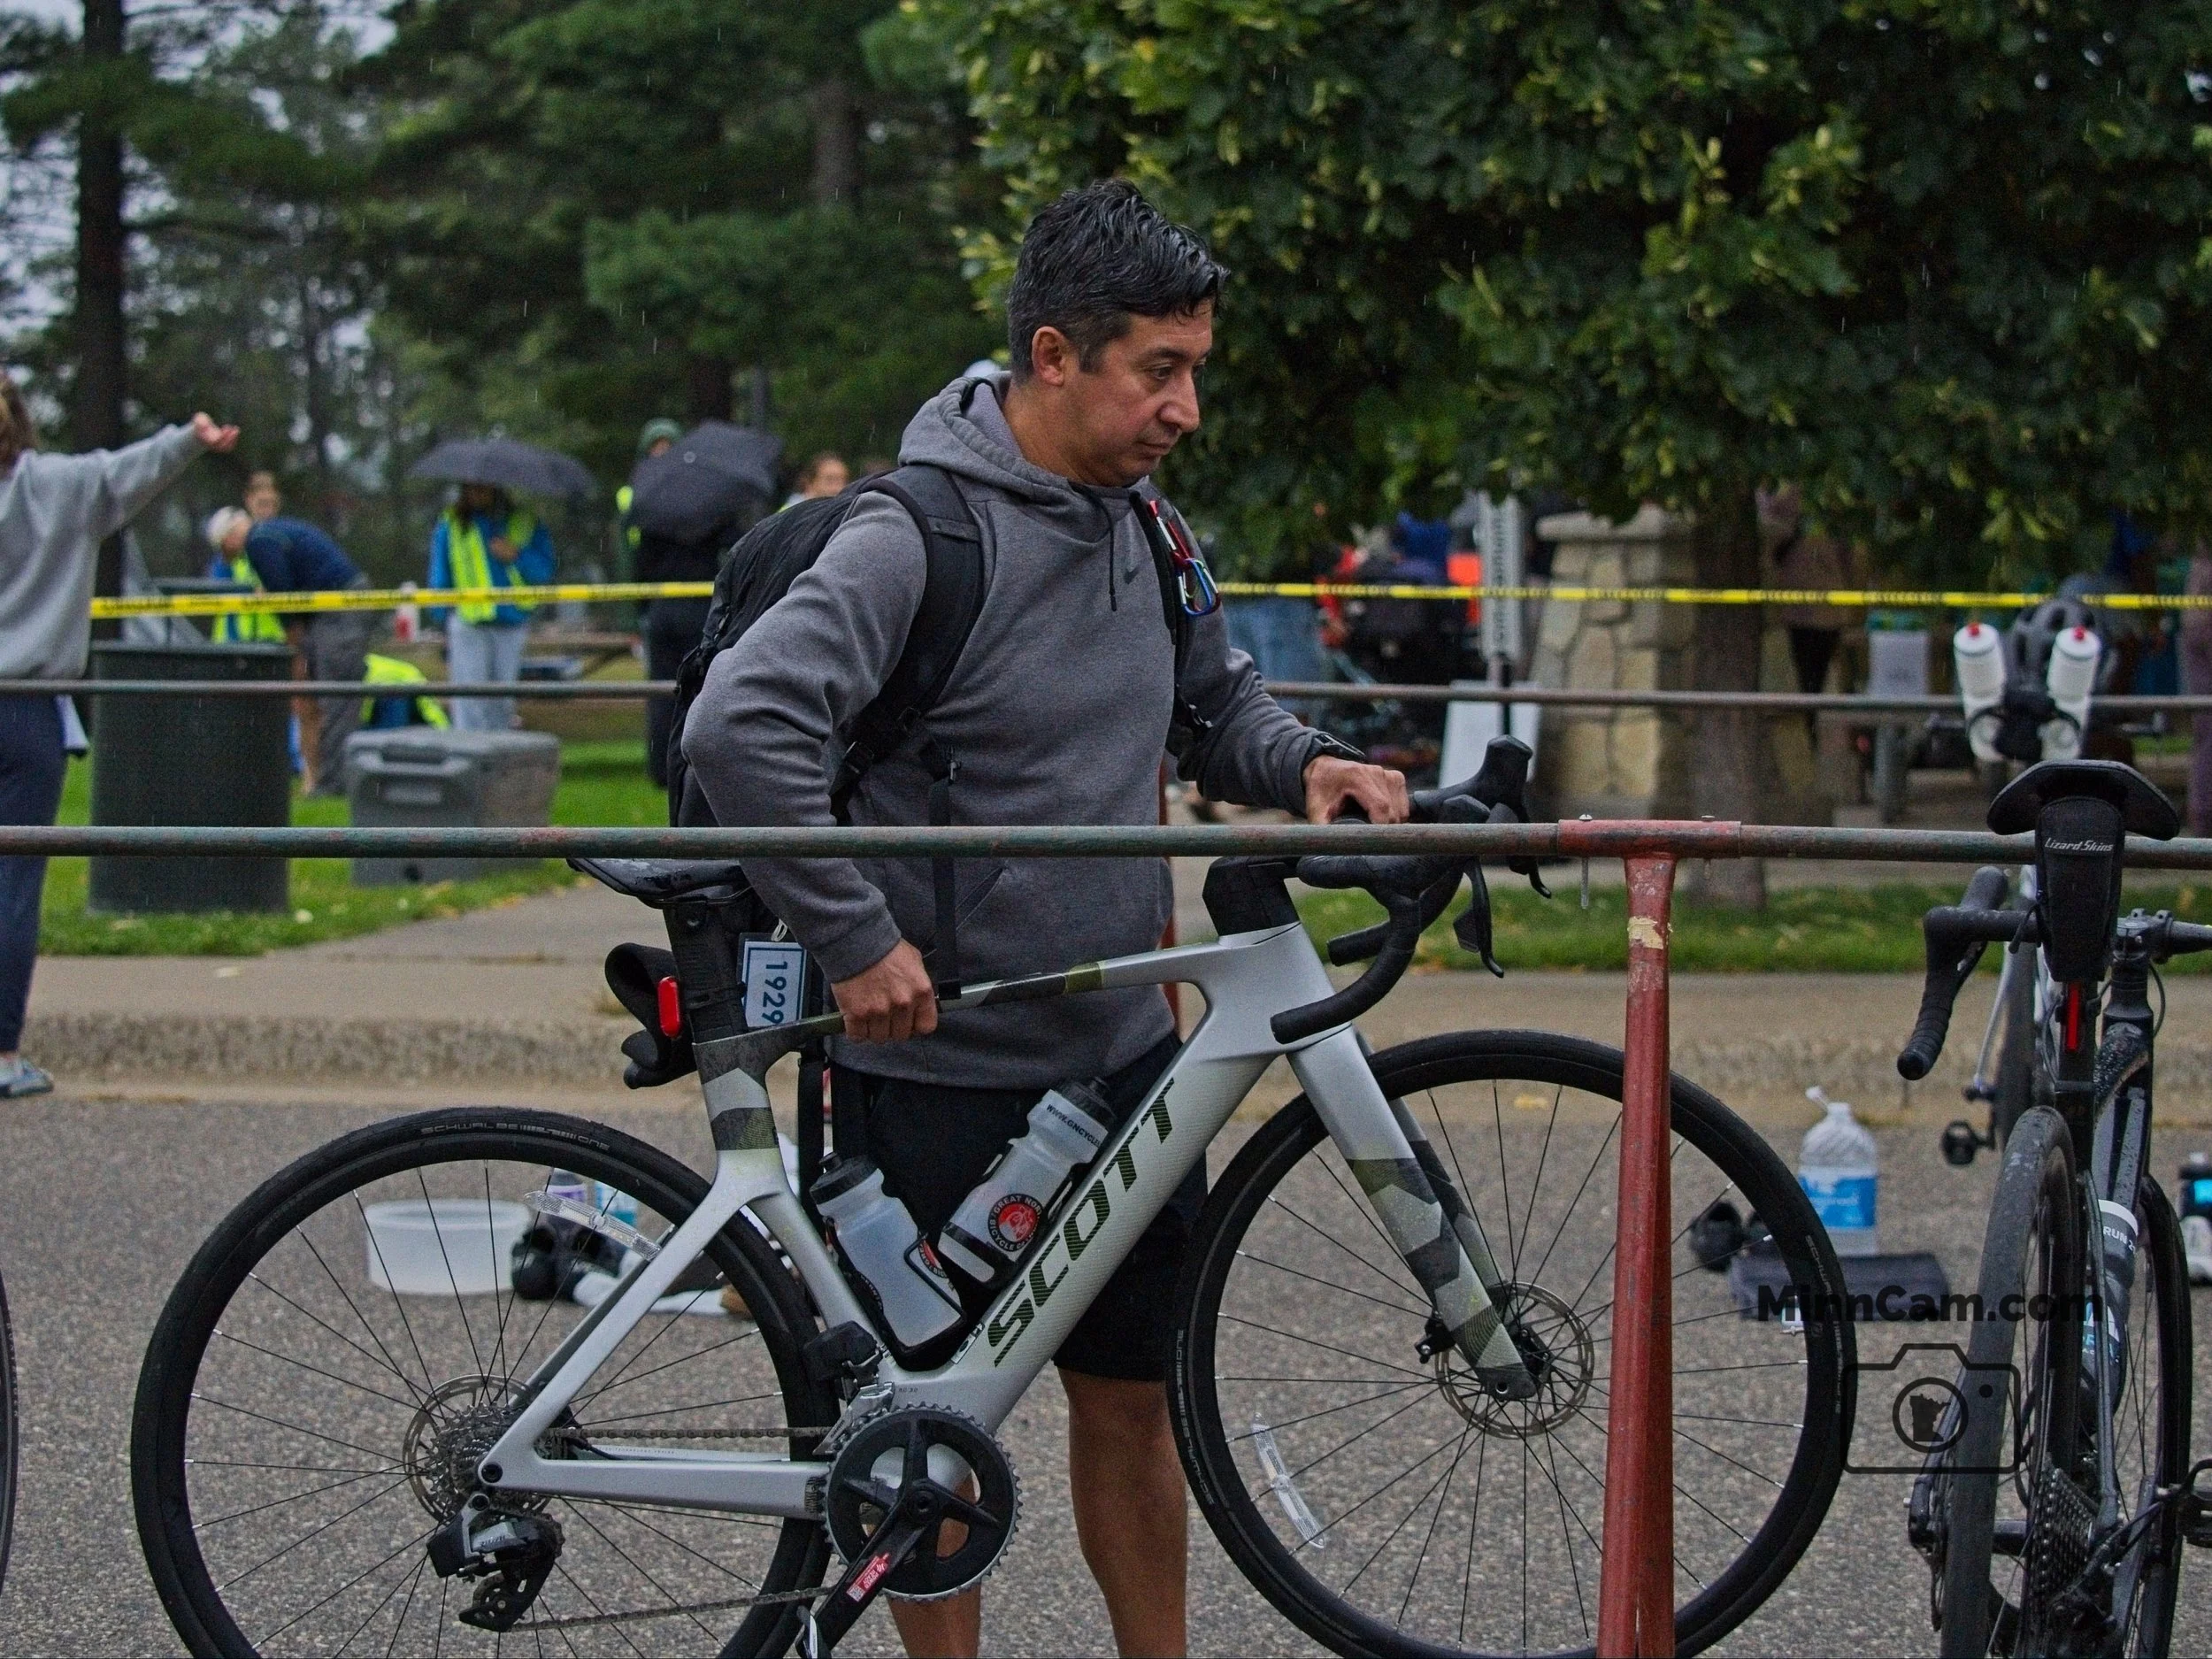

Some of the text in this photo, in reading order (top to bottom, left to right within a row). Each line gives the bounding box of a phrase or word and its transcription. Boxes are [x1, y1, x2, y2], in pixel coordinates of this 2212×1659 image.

[2044, 837, 2114, 851] Lizard Skins
[761, 961, 788, 1025] 1929
[420, 1122, 518, 1135] SCHWALBE
[993, 1194, 1022, 1214] GREAT
[987, 1077, 1175, 1368] SCOTT
[989, 1220, 1015, 1251] BICYCLE
[2103, 1225, 2128, 1245] RUN
